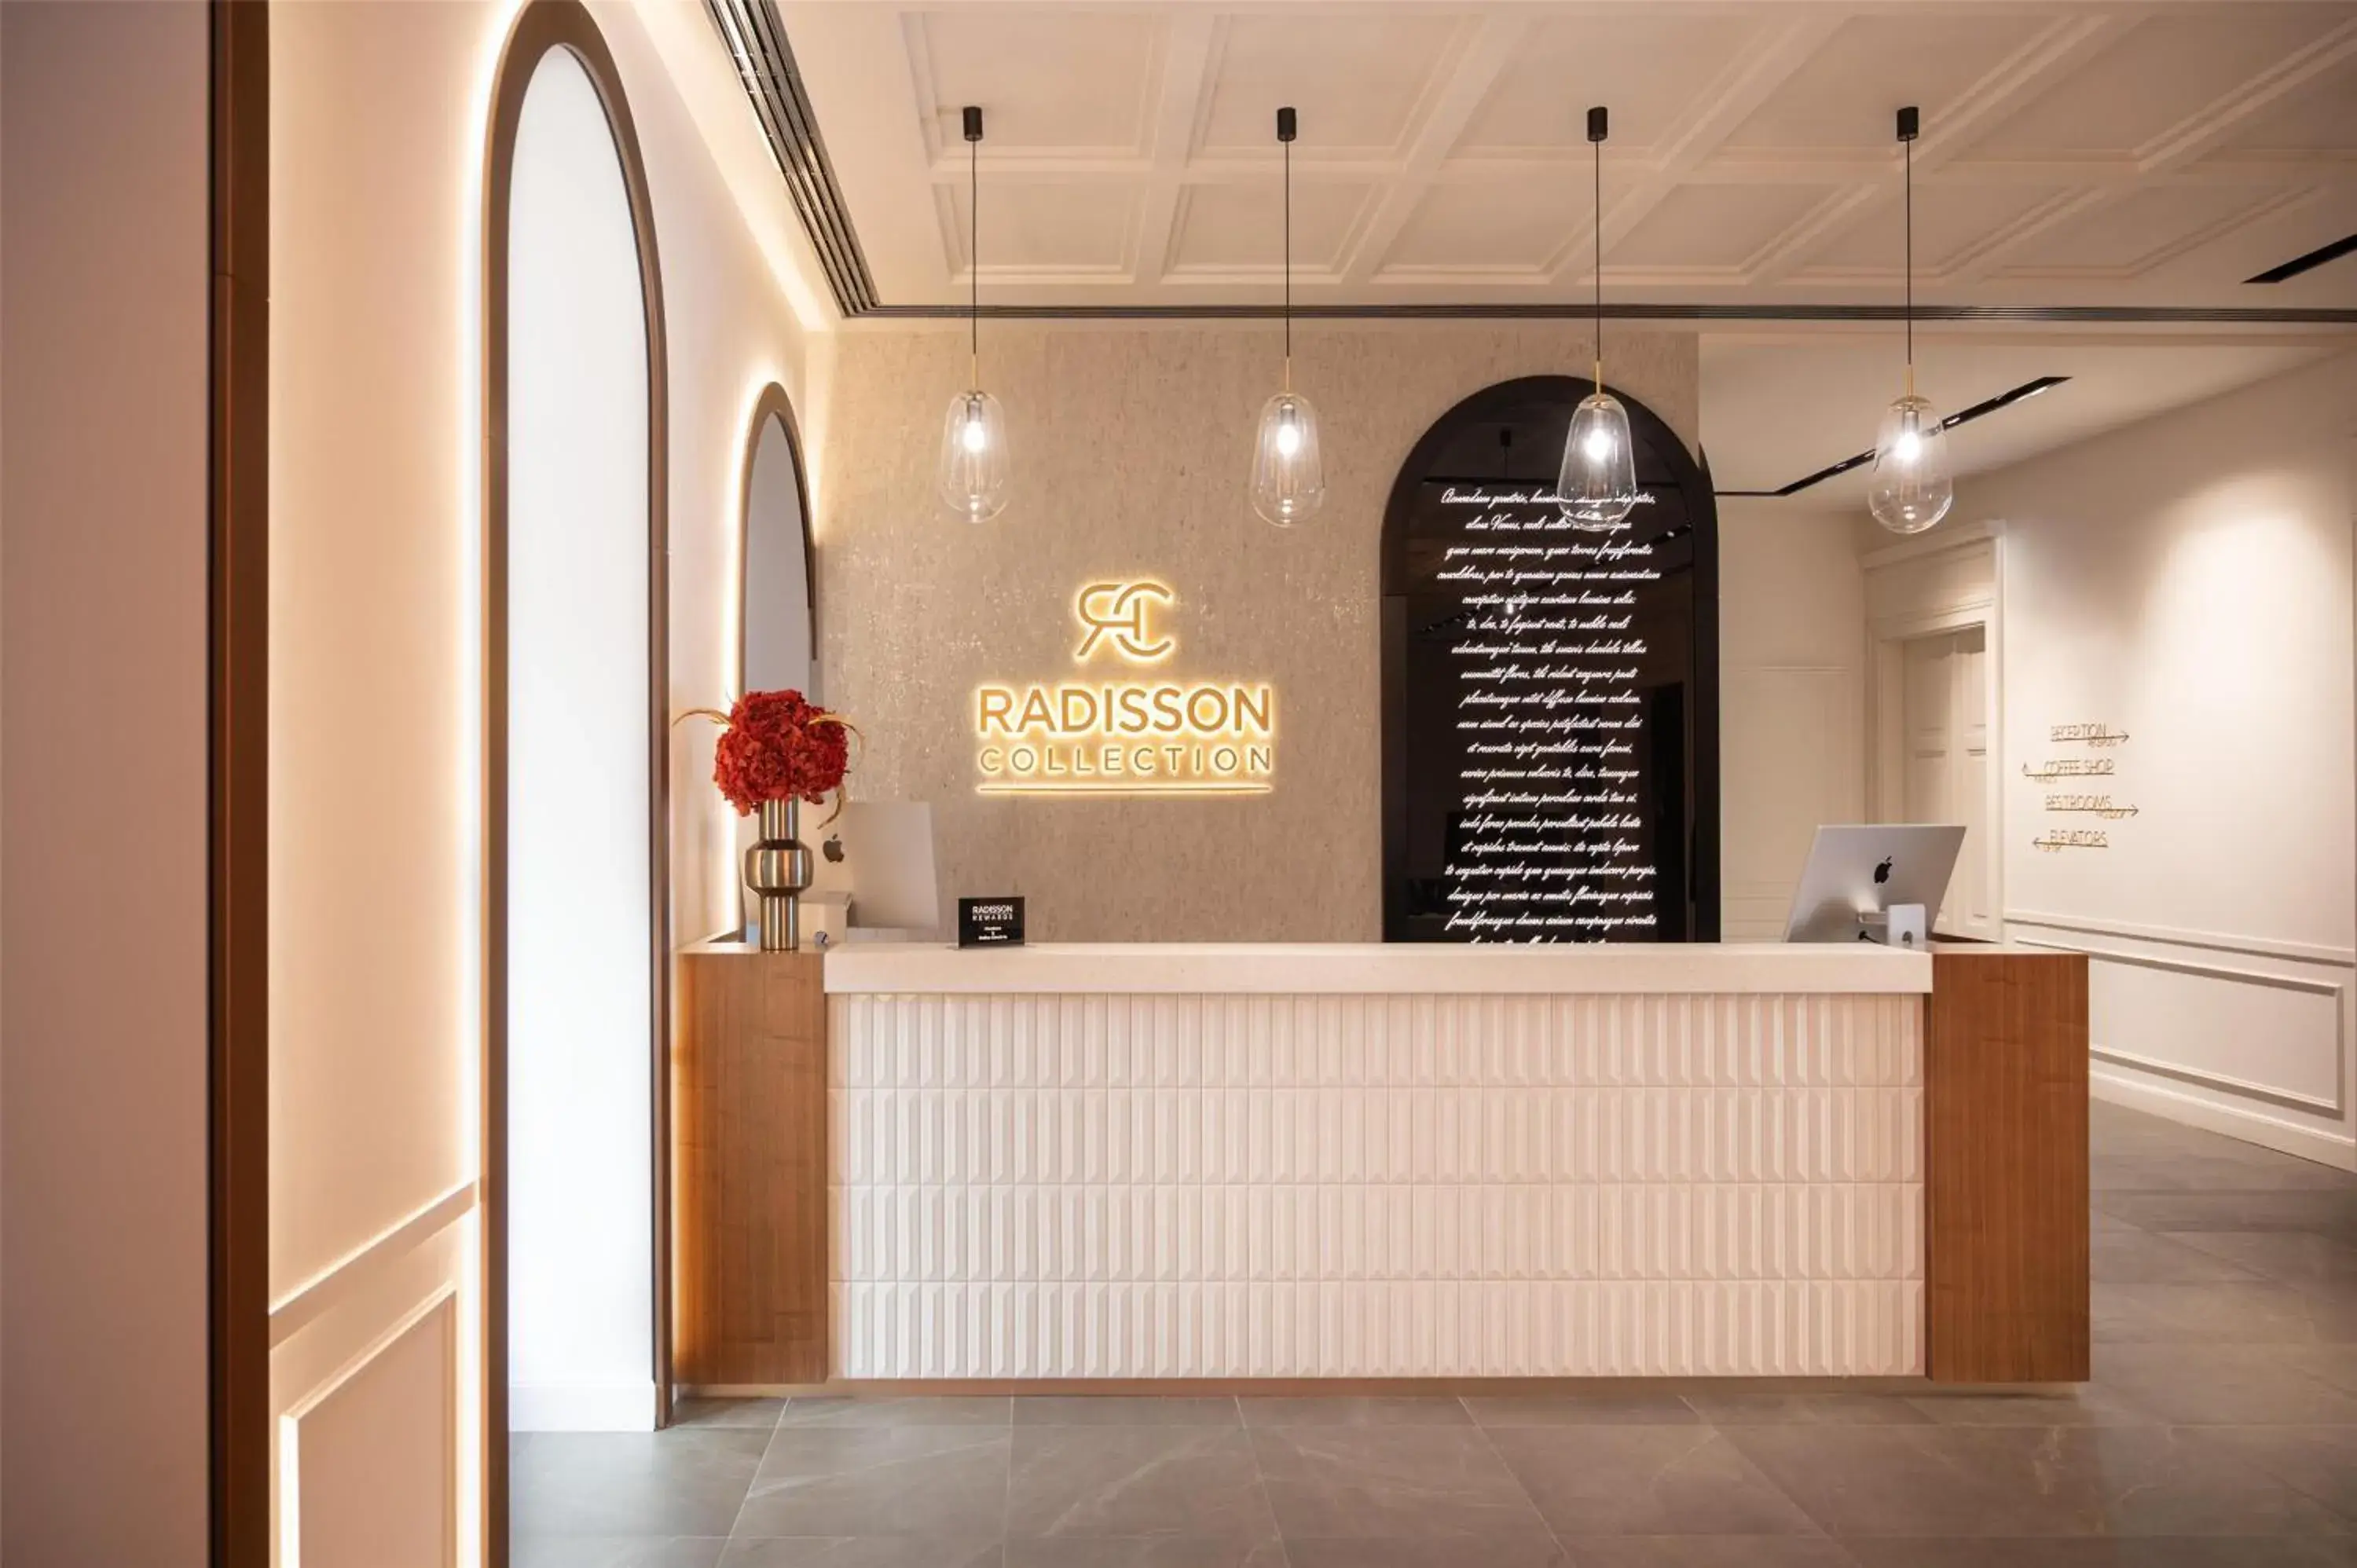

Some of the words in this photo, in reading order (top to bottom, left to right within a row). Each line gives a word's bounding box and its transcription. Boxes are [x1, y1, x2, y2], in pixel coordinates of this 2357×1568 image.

[980, 688, 1270, 732] RADISSON
[980, 748, 1270, 771] COLLECTION
[2044, 760, 2080, 774] COFFEE
[2084, 758, 2115, 773] SHOP
[973, 904, 1013, 914] RADISSON
